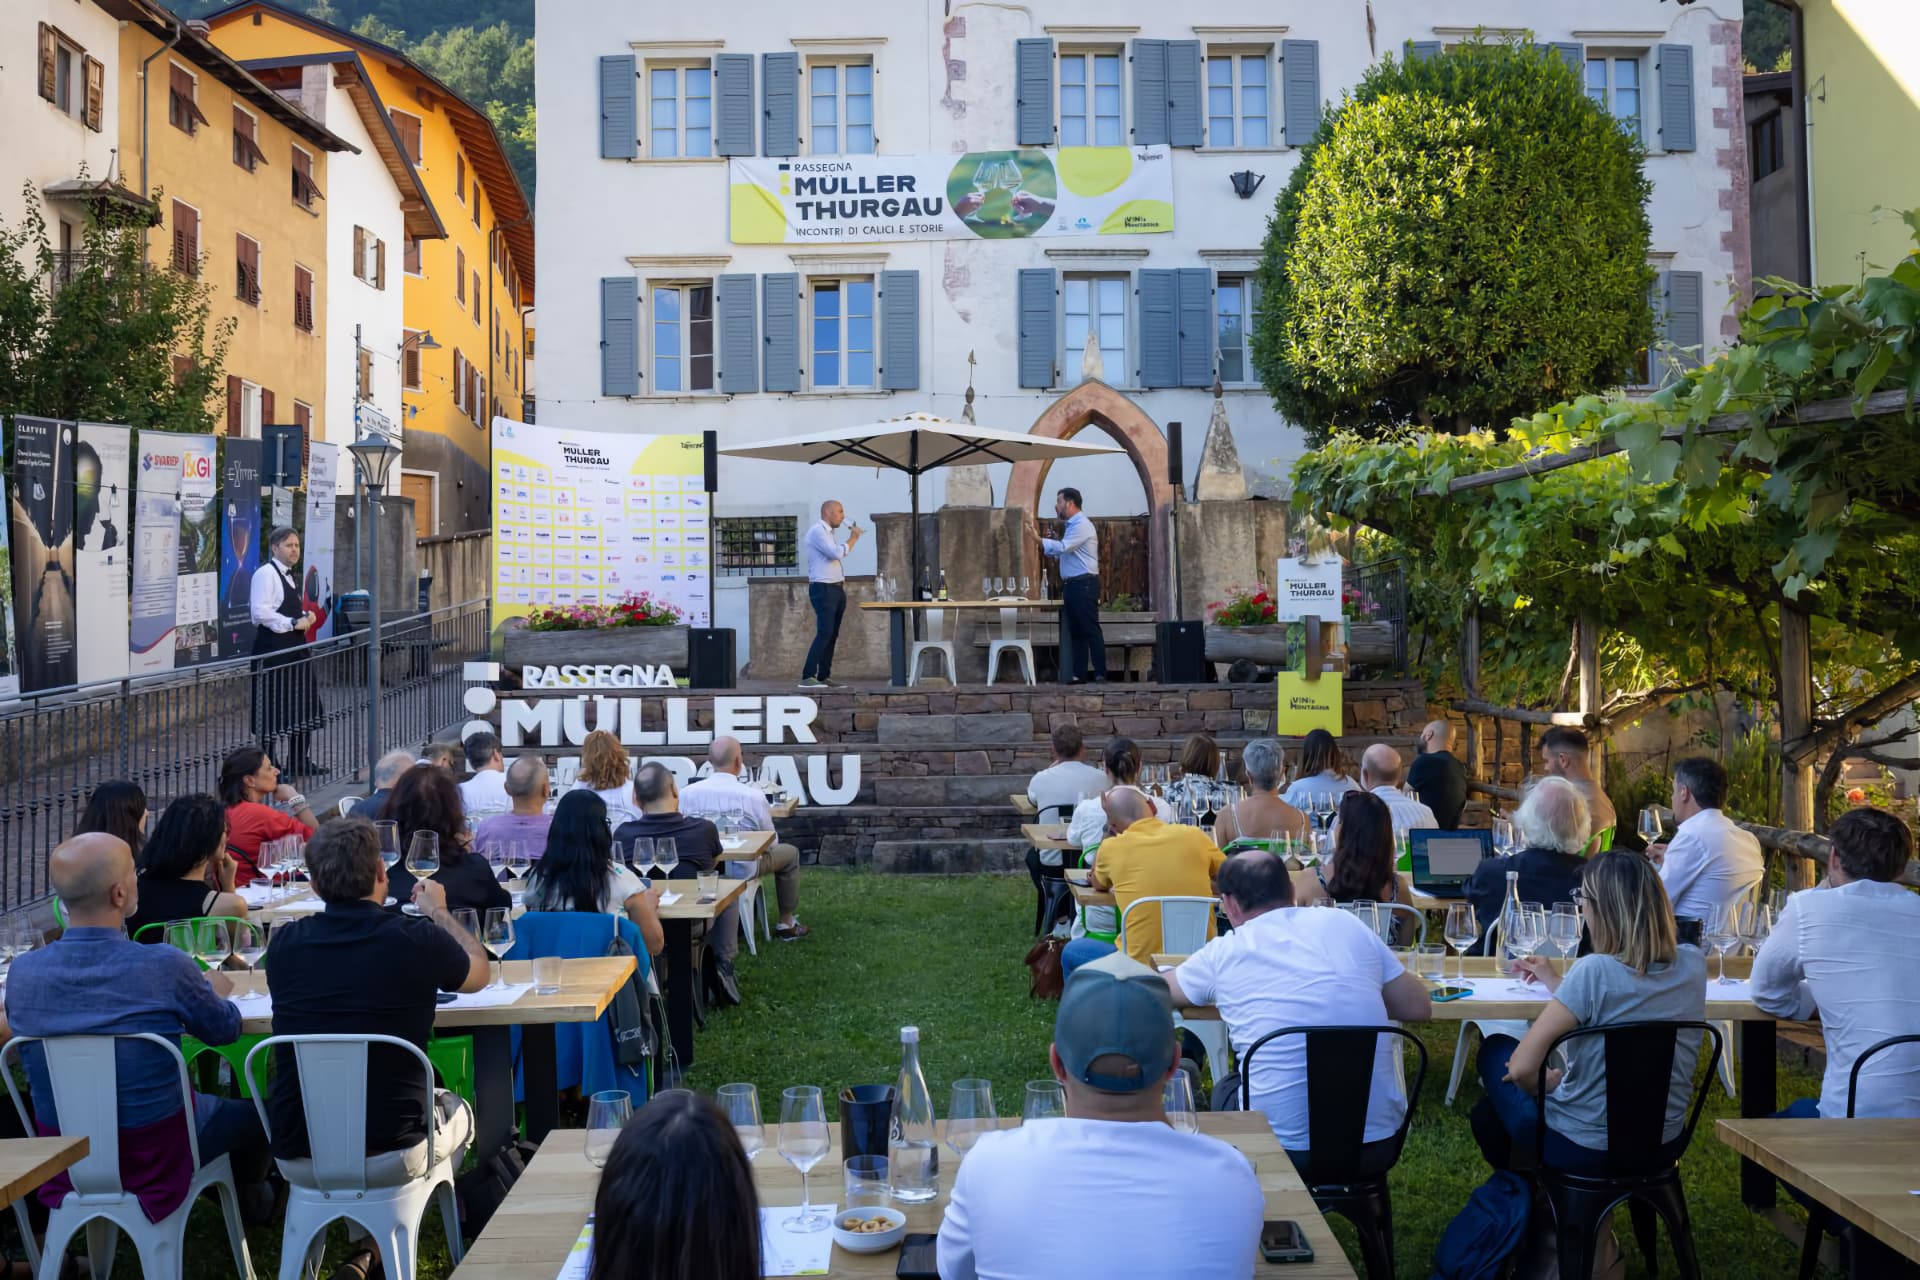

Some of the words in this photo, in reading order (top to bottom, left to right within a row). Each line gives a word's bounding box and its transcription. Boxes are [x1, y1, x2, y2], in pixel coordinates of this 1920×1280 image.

[794, 162, 853, 173] RASSEGNA
[795, 174, 917, 197] MÜLLER
[795, 196, 944, 221] THURGAU
[796, 226, 844, 237] INCONTRI
[848, 226, 858, 236] DI
[862, 225, 895, 235] CALICI
[899, 224, 905, 234] E
[909, 223, 944, 234] STORIE
[522, 663, 678, 689] RASSEGNA
[501, 694, 819, 748] MÜLLER
